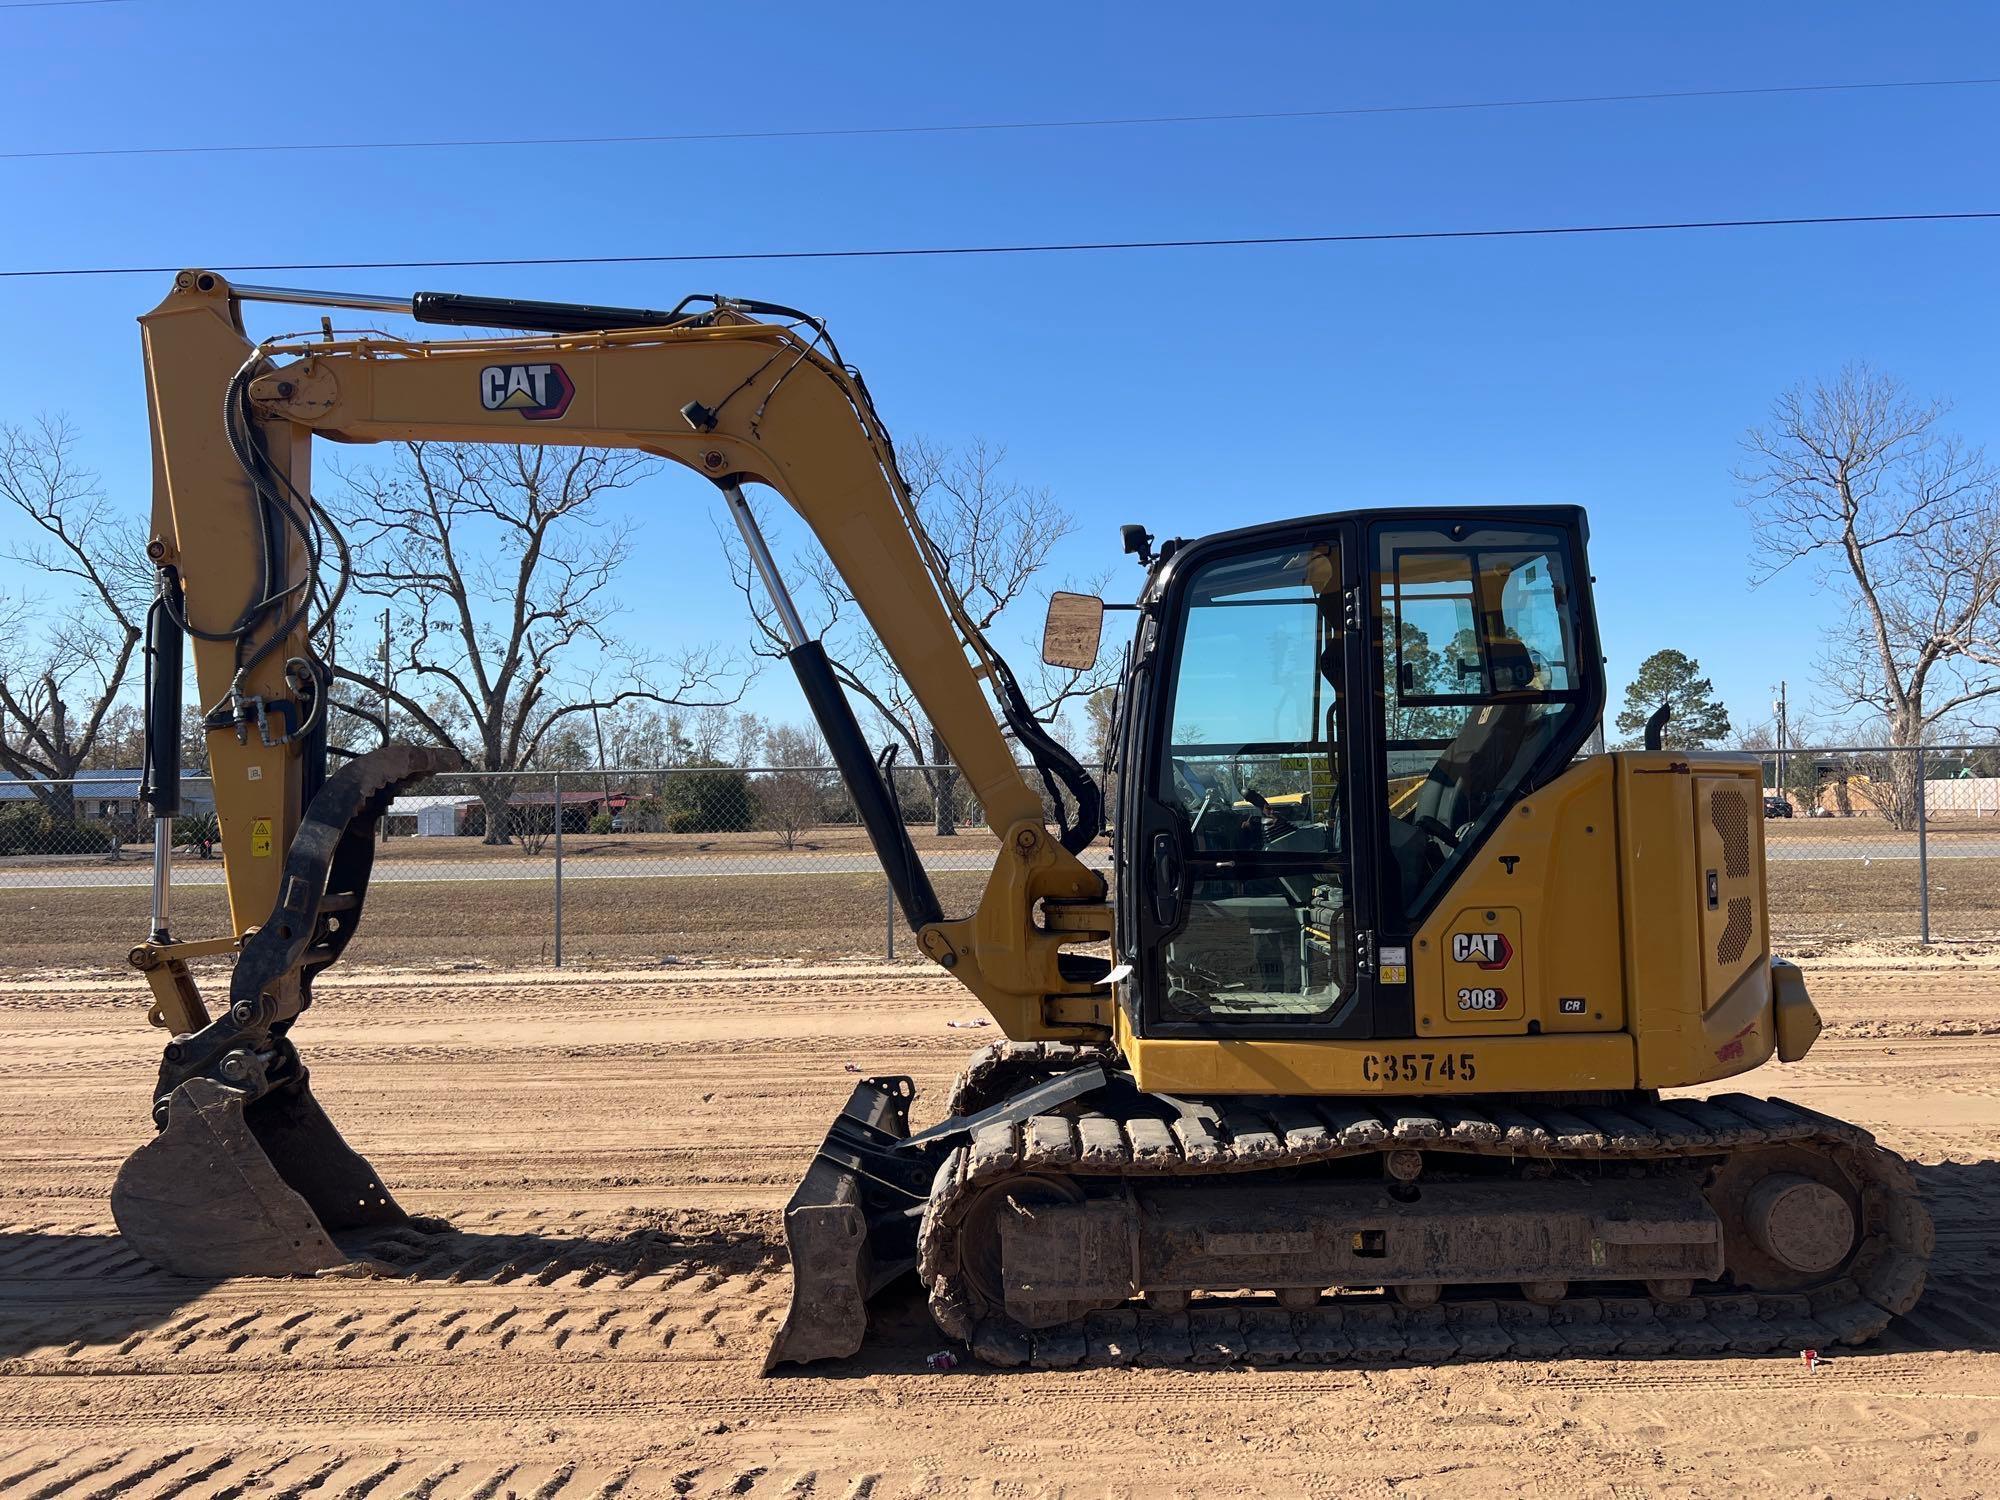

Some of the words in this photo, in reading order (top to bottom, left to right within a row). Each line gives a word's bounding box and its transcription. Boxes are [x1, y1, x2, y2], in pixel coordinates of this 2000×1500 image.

[482, 365, 551, 409] CAT
[1453, 933, 1499, 962] CAT
[1458, 989, 1497, 1010] 308
[1564, 1000, 1581, 1011] CR
[1363, 1054, 1476, 1082] C35745
